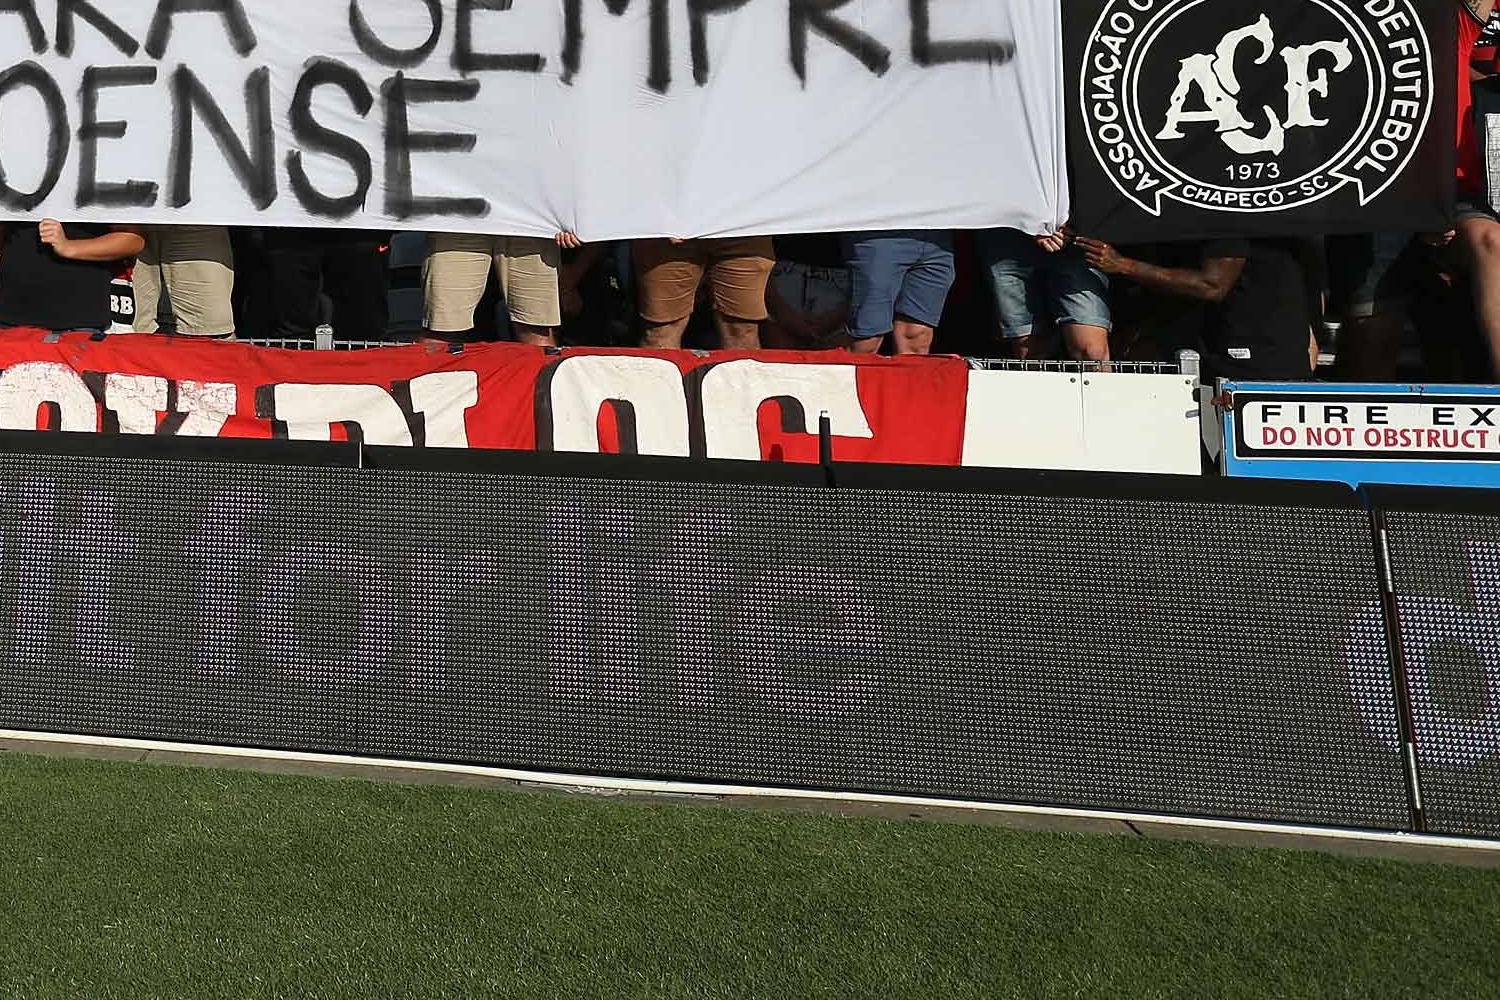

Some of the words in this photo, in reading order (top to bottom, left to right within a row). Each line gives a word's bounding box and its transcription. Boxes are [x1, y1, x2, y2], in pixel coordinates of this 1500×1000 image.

[1091, 11, 1160, 191] ASSOCIAÇÃO
[1353, 37, 1422, 173] FUTEBOL
[1225, 161, 1281, 182] 1973
[1261, 404, 1389, 424] FIRE
[1262, 426, 1297, 446] DO
[1306, 426, 1355, 447] NOT
[1364, 427, 1489, 449] OBSTRUCT
[183, 486, 496, 694] for
[546, 499, 888, 718] life
